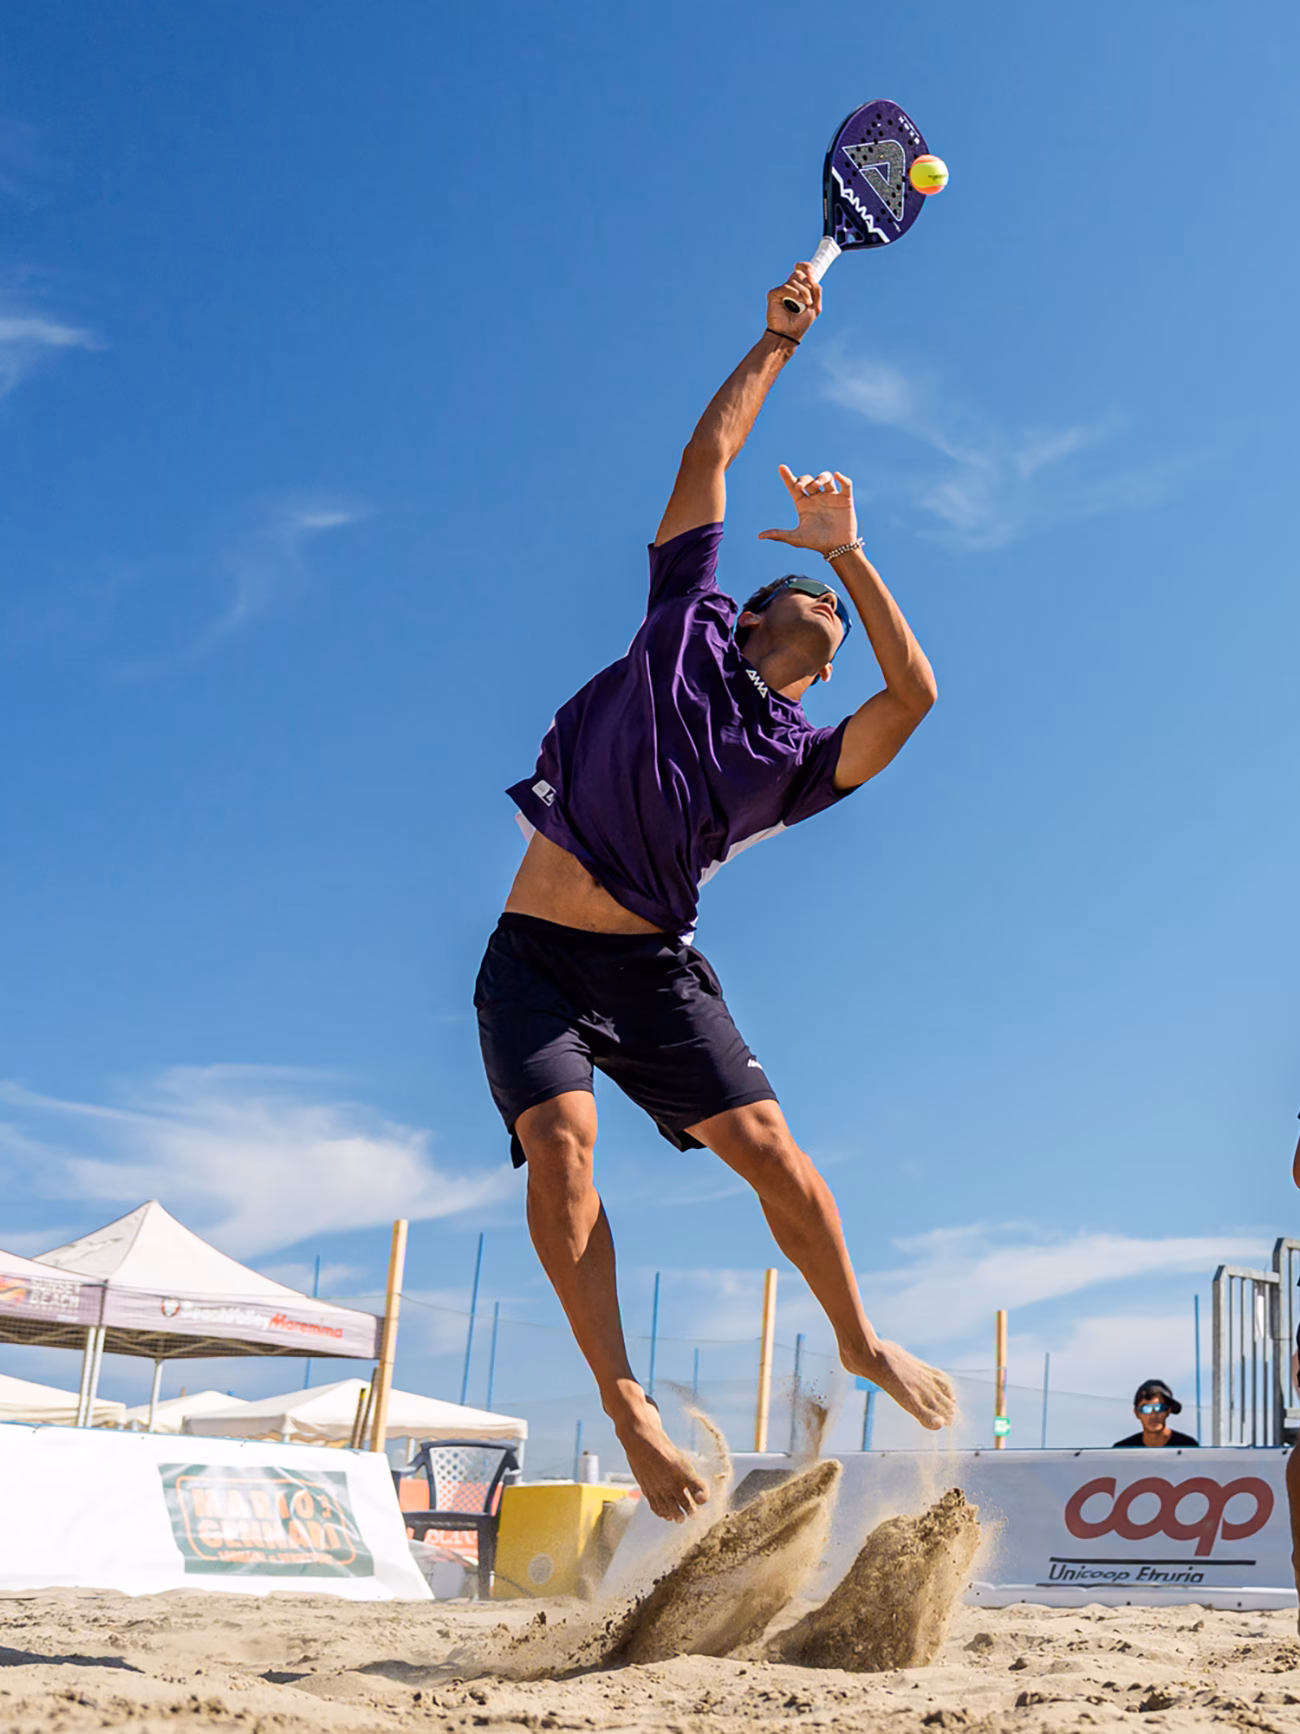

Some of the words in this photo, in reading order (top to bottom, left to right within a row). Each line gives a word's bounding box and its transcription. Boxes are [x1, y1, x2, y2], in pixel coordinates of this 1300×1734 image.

[29, 1290, 81, 1309] BEACH
[1064, 1476, 1275, 1557] coop
[1048, 1563, 1132, 1583] Unicoop
